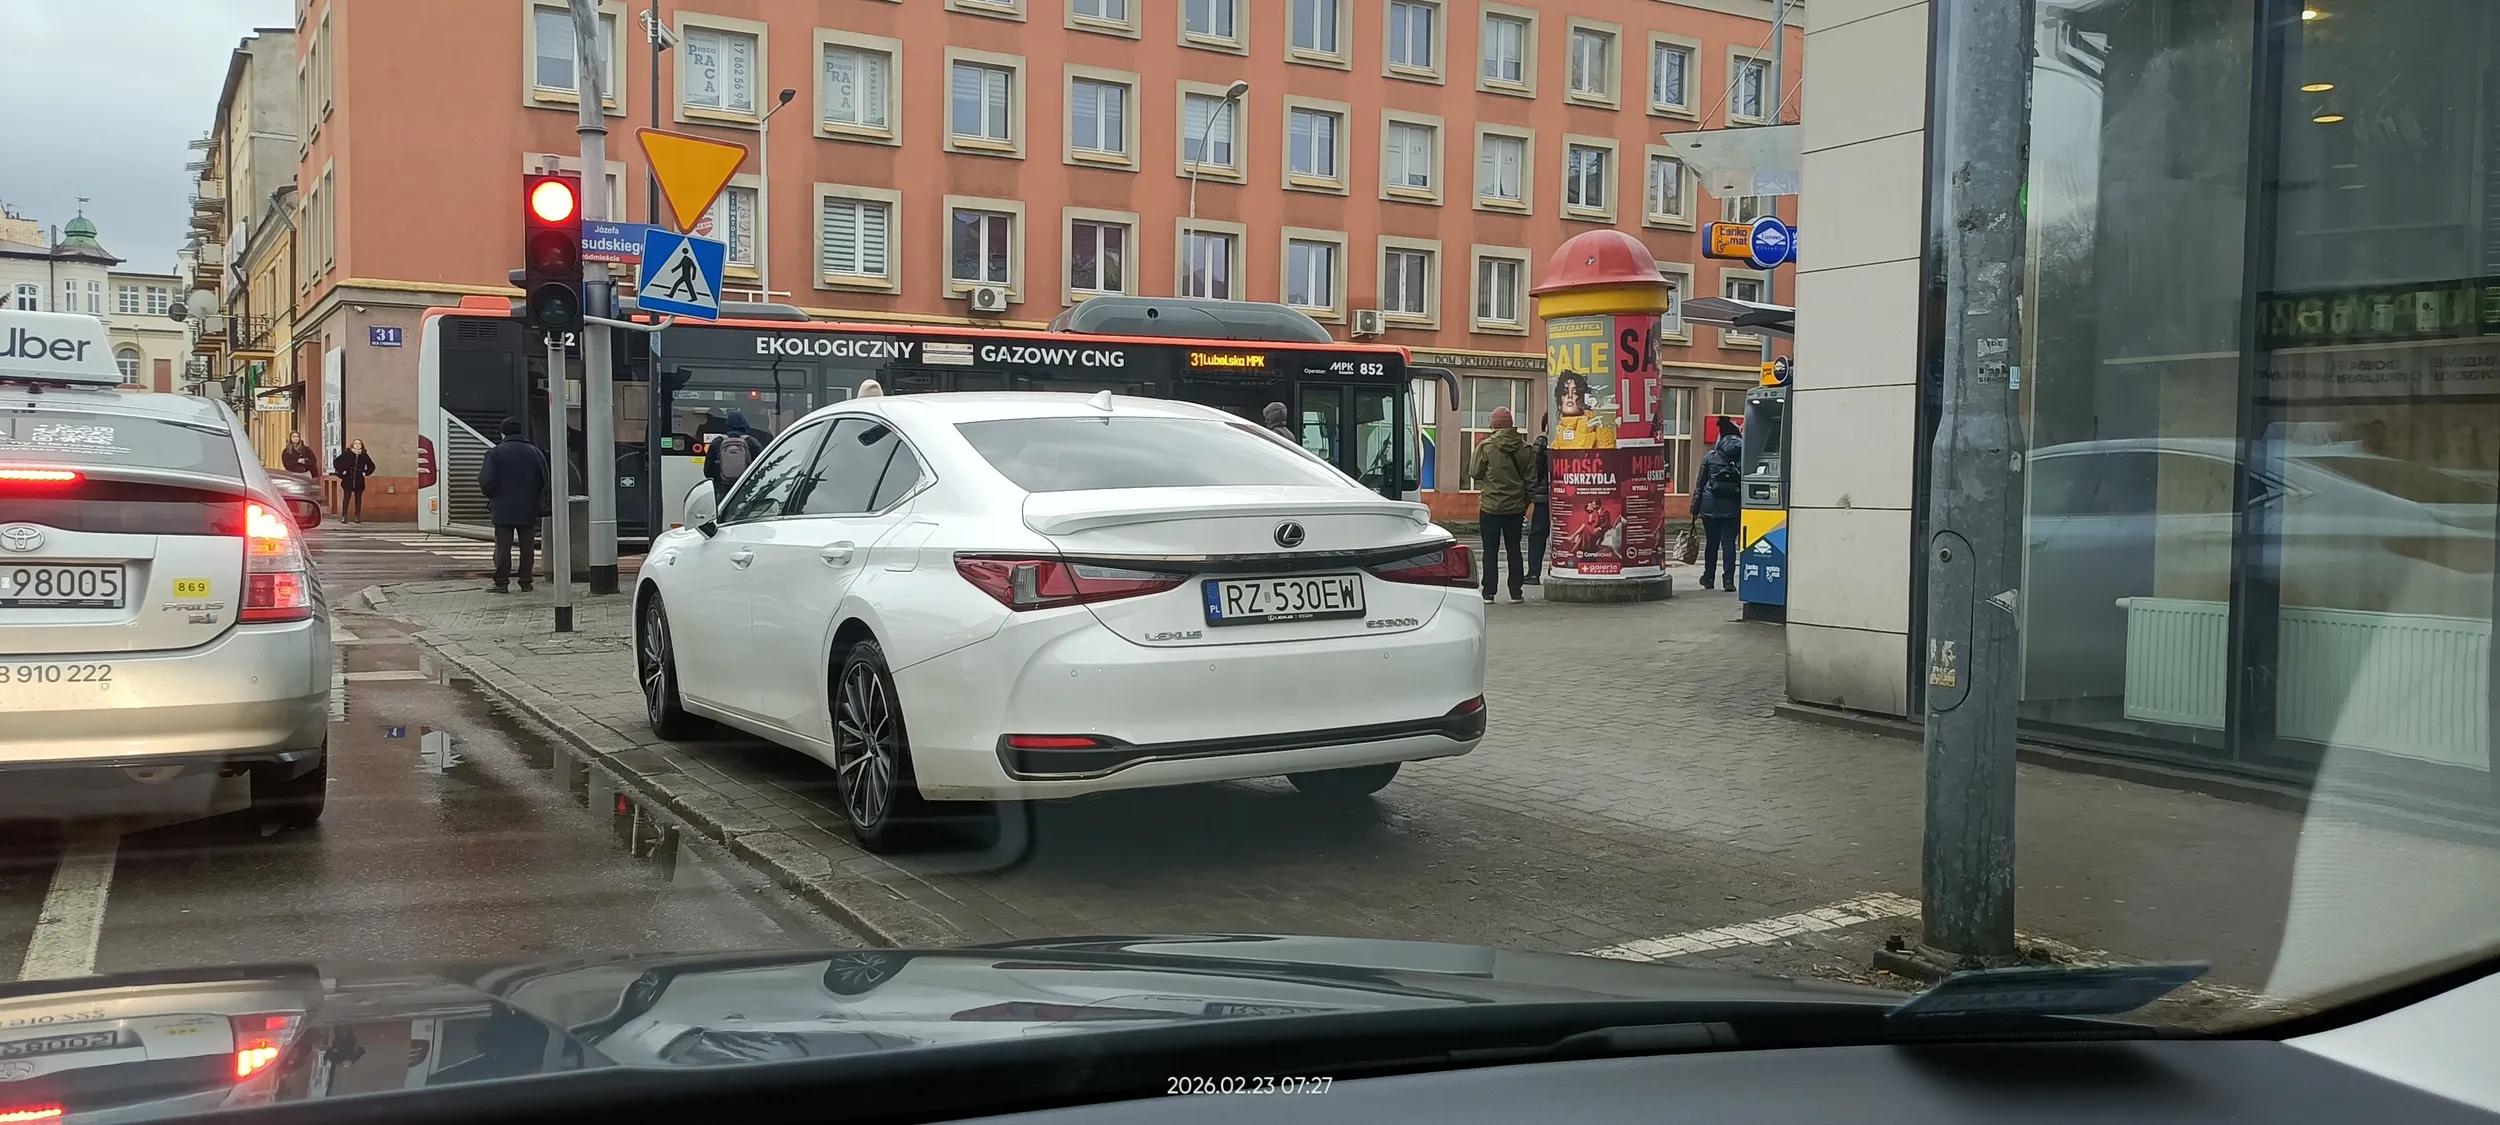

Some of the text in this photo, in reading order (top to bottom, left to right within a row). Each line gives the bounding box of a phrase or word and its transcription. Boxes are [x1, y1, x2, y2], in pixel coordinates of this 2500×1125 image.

[734, 57, 744, 75] 862
[594, 225, 619, 235] Józefa
[1720, 226, 1748, 237] banko
[581, 236, 644, 256] sudskieg
[1730, 237, 1747, 246] mat
[375, 328, 394, 342] 31
[756, 336, 914, 360] EKOLOGICZNY
[981, 345, 1077, 367] GAZOWY
[1081, 350, 1125, 367] CNG
[1190, 352, 1265, 368] 31 Lubelska MPK
[1330, 361, 1354, 371] MPK
[1434, 355, 1456, 365] DOM
[1547, 343, 1609, 377] SALE
[1360, 363, 1384, 376] 852
[1622, 378, 1657, 422] LE
[1553, 453, 1603, 476] MIŁOŚĆ
[1563, 472, 1616, 485] USKRZYDLA
[12, 568, 118, 597] 98005
[1226, 578, 1355, 615] RZ 530EW
[162, 602, 225, 611] PRIUS
[1209, 605, 1220, 614] PL
[1145, 630, 1203, 641] LEXUS
[16, 665, 61, 684] 910
[67, 664, 112, 682] 222
